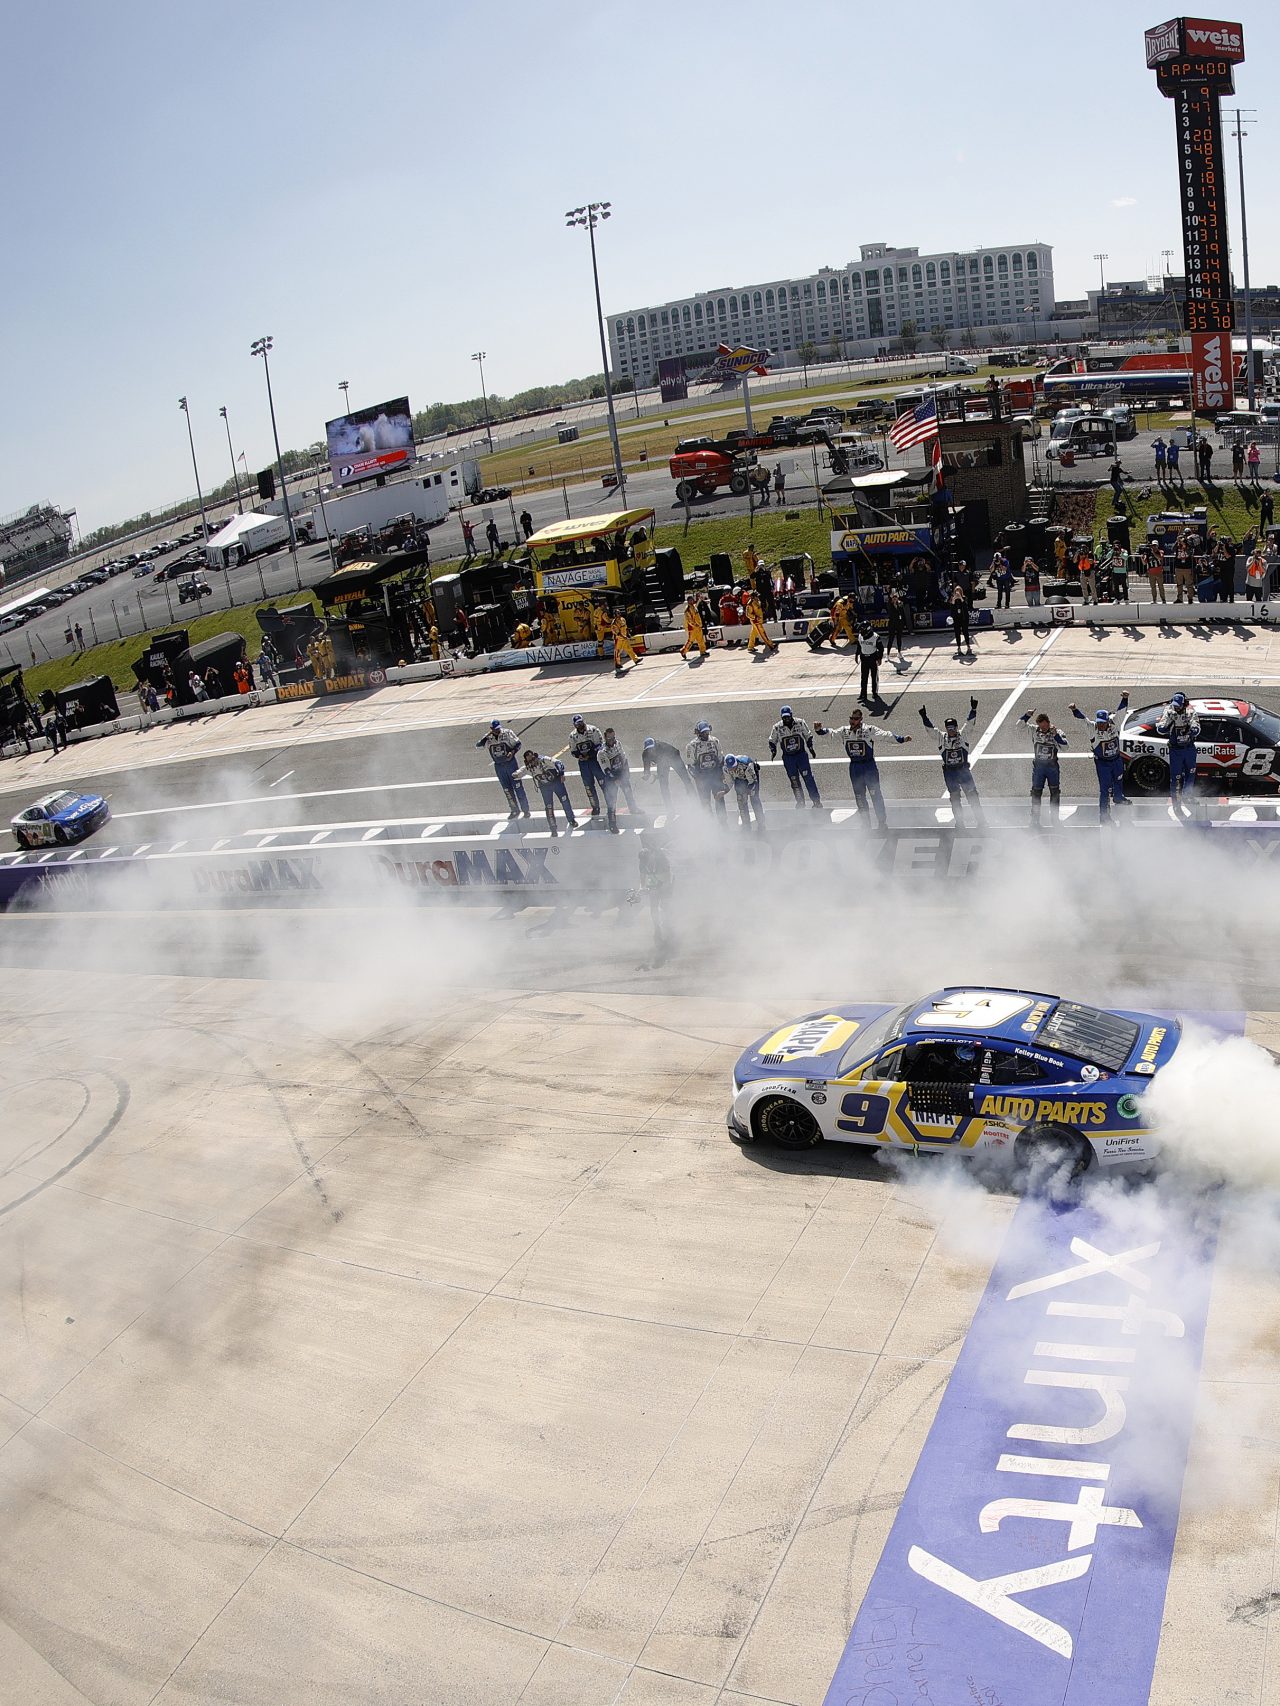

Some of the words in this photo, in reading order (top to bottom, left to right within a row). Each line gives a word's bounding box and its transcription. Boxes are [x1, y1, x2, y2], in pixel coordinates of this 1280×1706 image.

[1146, 26, 1180, 60] DRYDENE
[1187, 29, 1240, 46] weis
[1161, 64, 1187, 77] LAP
[1195, 62, 1226, 75] 400
[1181, 90, 1187, 99] 1
[1182, 104, 1188, 113] 2
[1191, 102, 1210, 113] 47
[1183, 117, 1189, 126] 3
[1184, 131, 1190, 140] 4
[1193, 129, 1212, 141] 20
[1185, 145, 1191, 154] 5
[1194, 142, 1213, 155] 48
[1185, 159, 1192, 169] 6
[1186, 173, 1192, 183] 7
[1201, 172, 1215, 184] 18
[1187, 187, 1193, 197] 8
[1202, 185, 1215, 197] 17
[1188, 202, 1194, 211] 9
[1186, 216, 1198, 226] 10
[1199, 214, 1217, 227] 43
[1187, 231, 1199, 241] 11
[1200, 229, 1218, 242] 31
[1187, 245, 1200, 255] 12
[1206, 243, 1219, 255] 19
[1188, 259, 1200, 269] 13
[1206, 258, 1219, 269] 14
[1188, 274, 1201, 284] 14
[1202, 272, 1220, 284] 99
[1189, 288, 1202, 298] 15
[1203, 288, 1222, 299] 41
[720, 352, 767, 368] SUNOCO
[1204, 336, 1229, 407] weis
[341, 467, 347, 476] 9
[845, 540, 857, 548] NAP
[864, 533, 887, 544] AUTO
[547, 570, 588, 587] NAVAGE
[1056, 609, 1070, 618] GT
[1250, 604, 1269, 616] 16
[794, 621, 809, 635] 9
[871, 618, 890, 628] PART
[526, 644, 581, 663] NAVAGE
[326, 673, 365, 693] DEWALT
[278, 681, 315, 699] DEWALT
[176, 708, 184, 717] 20
[1123, 740, 1155, 754] Rate
[1215, 745, 1236, 755] Rate
[1242, 748, 1276, 776] 8
[914, 991, 1034, 1029] 9
[781, 1020, 838, 1054] NAPA
[1141, 1043, 1157, 1062] AUTO
[1149, 1027, 1167, 1046] PARTS
[1014, 1047, 1034, 1058] Kelley
[1034, 1053, 1048, 1062] Blue
[1048, 1056, 1065, 1068] Book
[762, 1084, 797, 1094] GOODYEAR
[762, 1100, 784, 1132] GOODYEAR
[836, 1092, 891, 1135] 9
[979, 1095, 1035, 1121] AUTO
[1036, 1099, 1108, 1124] PARTS
[915, 1111, 956, 1126] NAPA
[1106, 1138, 1139, 1146] UniFirst
[905, 1236, 1185, 1658] xfinity
